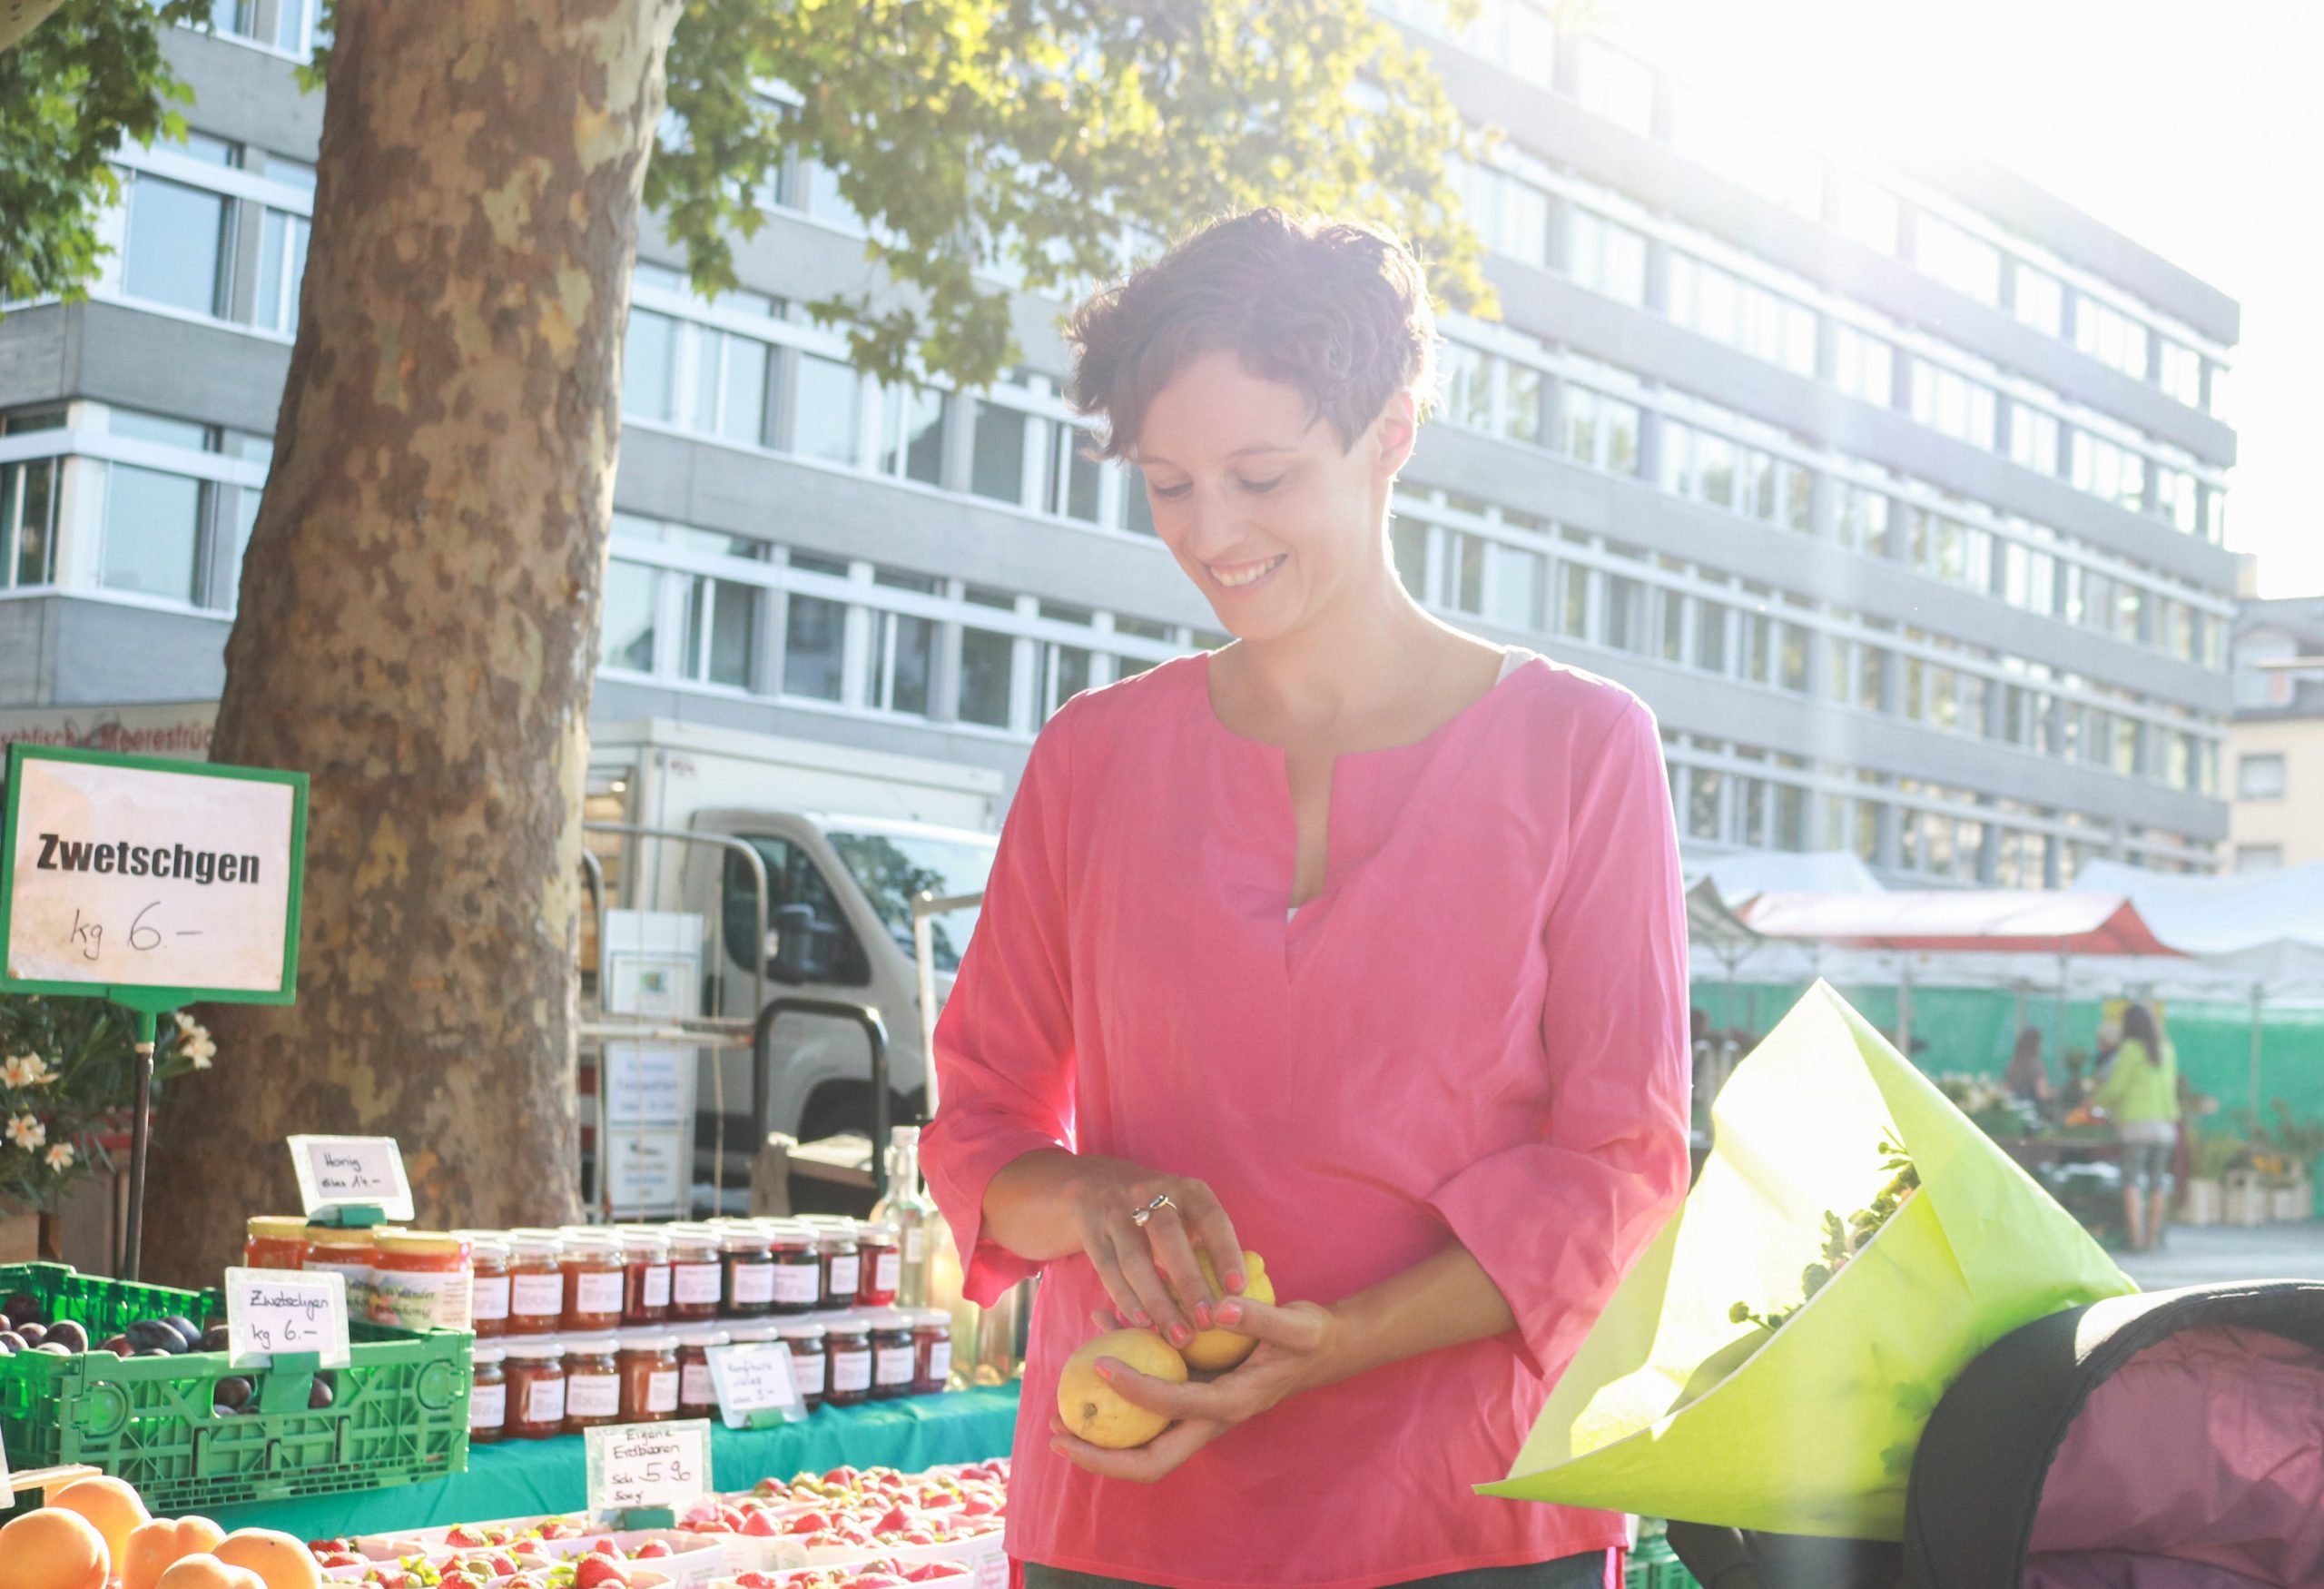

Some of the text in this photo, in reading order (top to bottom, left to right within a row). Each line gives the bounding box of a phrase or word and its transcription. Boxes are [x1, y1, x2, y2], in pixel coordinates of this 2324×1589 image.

[37, 834, 261, 885] Zwetschgen
[70, 908, 103, 961] kg
[323, 1152, 361, 1172] Honig
[250, 1289, 329, 1321] Zwetschgen
[251, 1318, 318, 1350] kg 6.-
